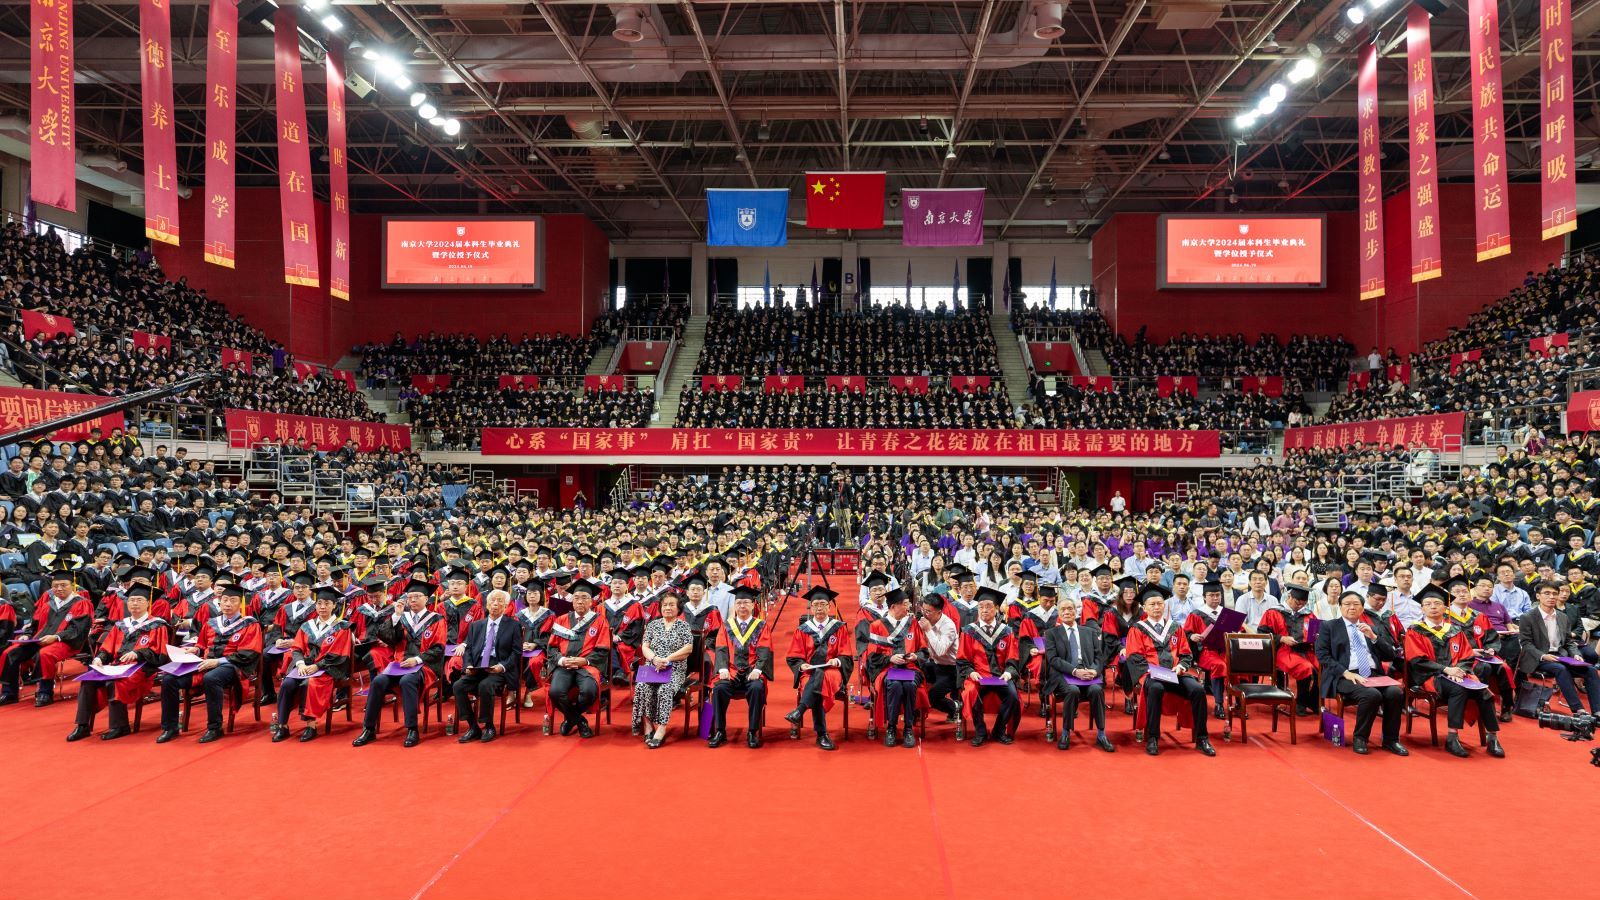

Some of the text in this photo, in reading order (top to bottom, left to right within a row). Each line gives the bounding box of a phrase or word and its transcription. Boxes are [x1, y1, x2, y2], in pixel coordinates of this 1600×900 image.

[60, 55, 71, 150] UNIVERSITY
[145, 0, 171, 191] 德养士
[211, 28, 232, 219] 至乐成学
[1478, 12, 1502, 212] 与民族共命运
[1545, 0, 1568, 184] 时代同呼吸
[281, 71, 310, 245] 吾道在国
[331, 100, 347, 262] 与世恒新
[1361, 97, 1379, 261] 求科教之进步
[1412, 58, 1434, 239] 谋国家之强盛
[401, 240, 521, 248] 南京大学2024届本科生毕业典礼
[432, 251, 489, 259] 暨学位授予仪式
[845, 273, 853, 284] B
[1182, 238, 1306, 247] 南京大学2024届本科生毕业典礼
[1214, 250, 1274, 258] 暨学位授予仪式
[275, 418, 401, 449] 报效国家 服务人民
[505, 431, 1196, 453] 心系“国家事” 肩扛“国家责” 让青春之花绽放在祖国最需要的地方
[1312, 419, 1446, 450] 再创佳绩 争做表率
